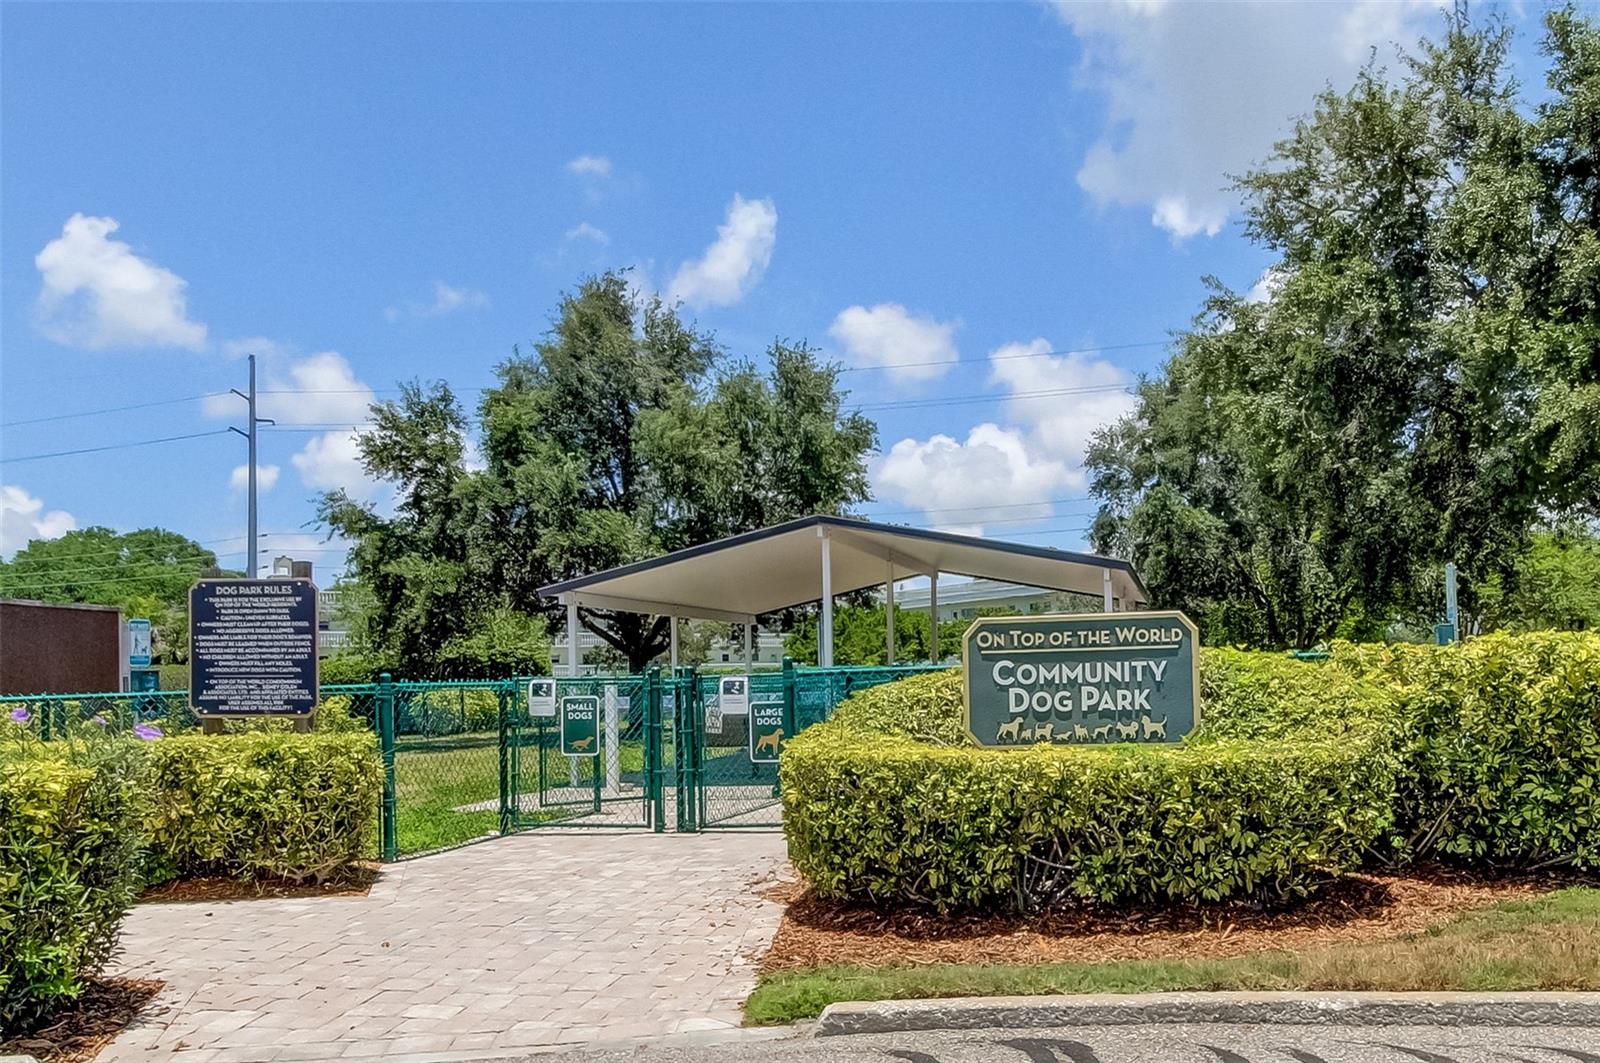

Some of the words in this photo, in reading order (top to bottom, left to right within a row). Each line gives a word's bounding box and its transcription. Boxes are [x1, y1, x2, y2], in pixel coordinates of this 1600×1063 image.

[216, 586, 238, 594] DOG
[239, 586, 263, 594] PARK
[264, 586, 292, 594] RULES
[976, 632, 1005, 647] ON
[1010, 630, 1044, 646] TOP
[1050, 632, 1072, 645] OF
[1078, 631, 1110, 644] THE
[1115, 626, 1183, 643] WORLD
[992, 660, 1167, 686] COMMUNITY
[1009, 687, 1072, 713] DOG
[1081, 686, 1151, 711] PARK
[566, 703, 594, 711] SMALL
[755, 708, 783, 716] LARGE
